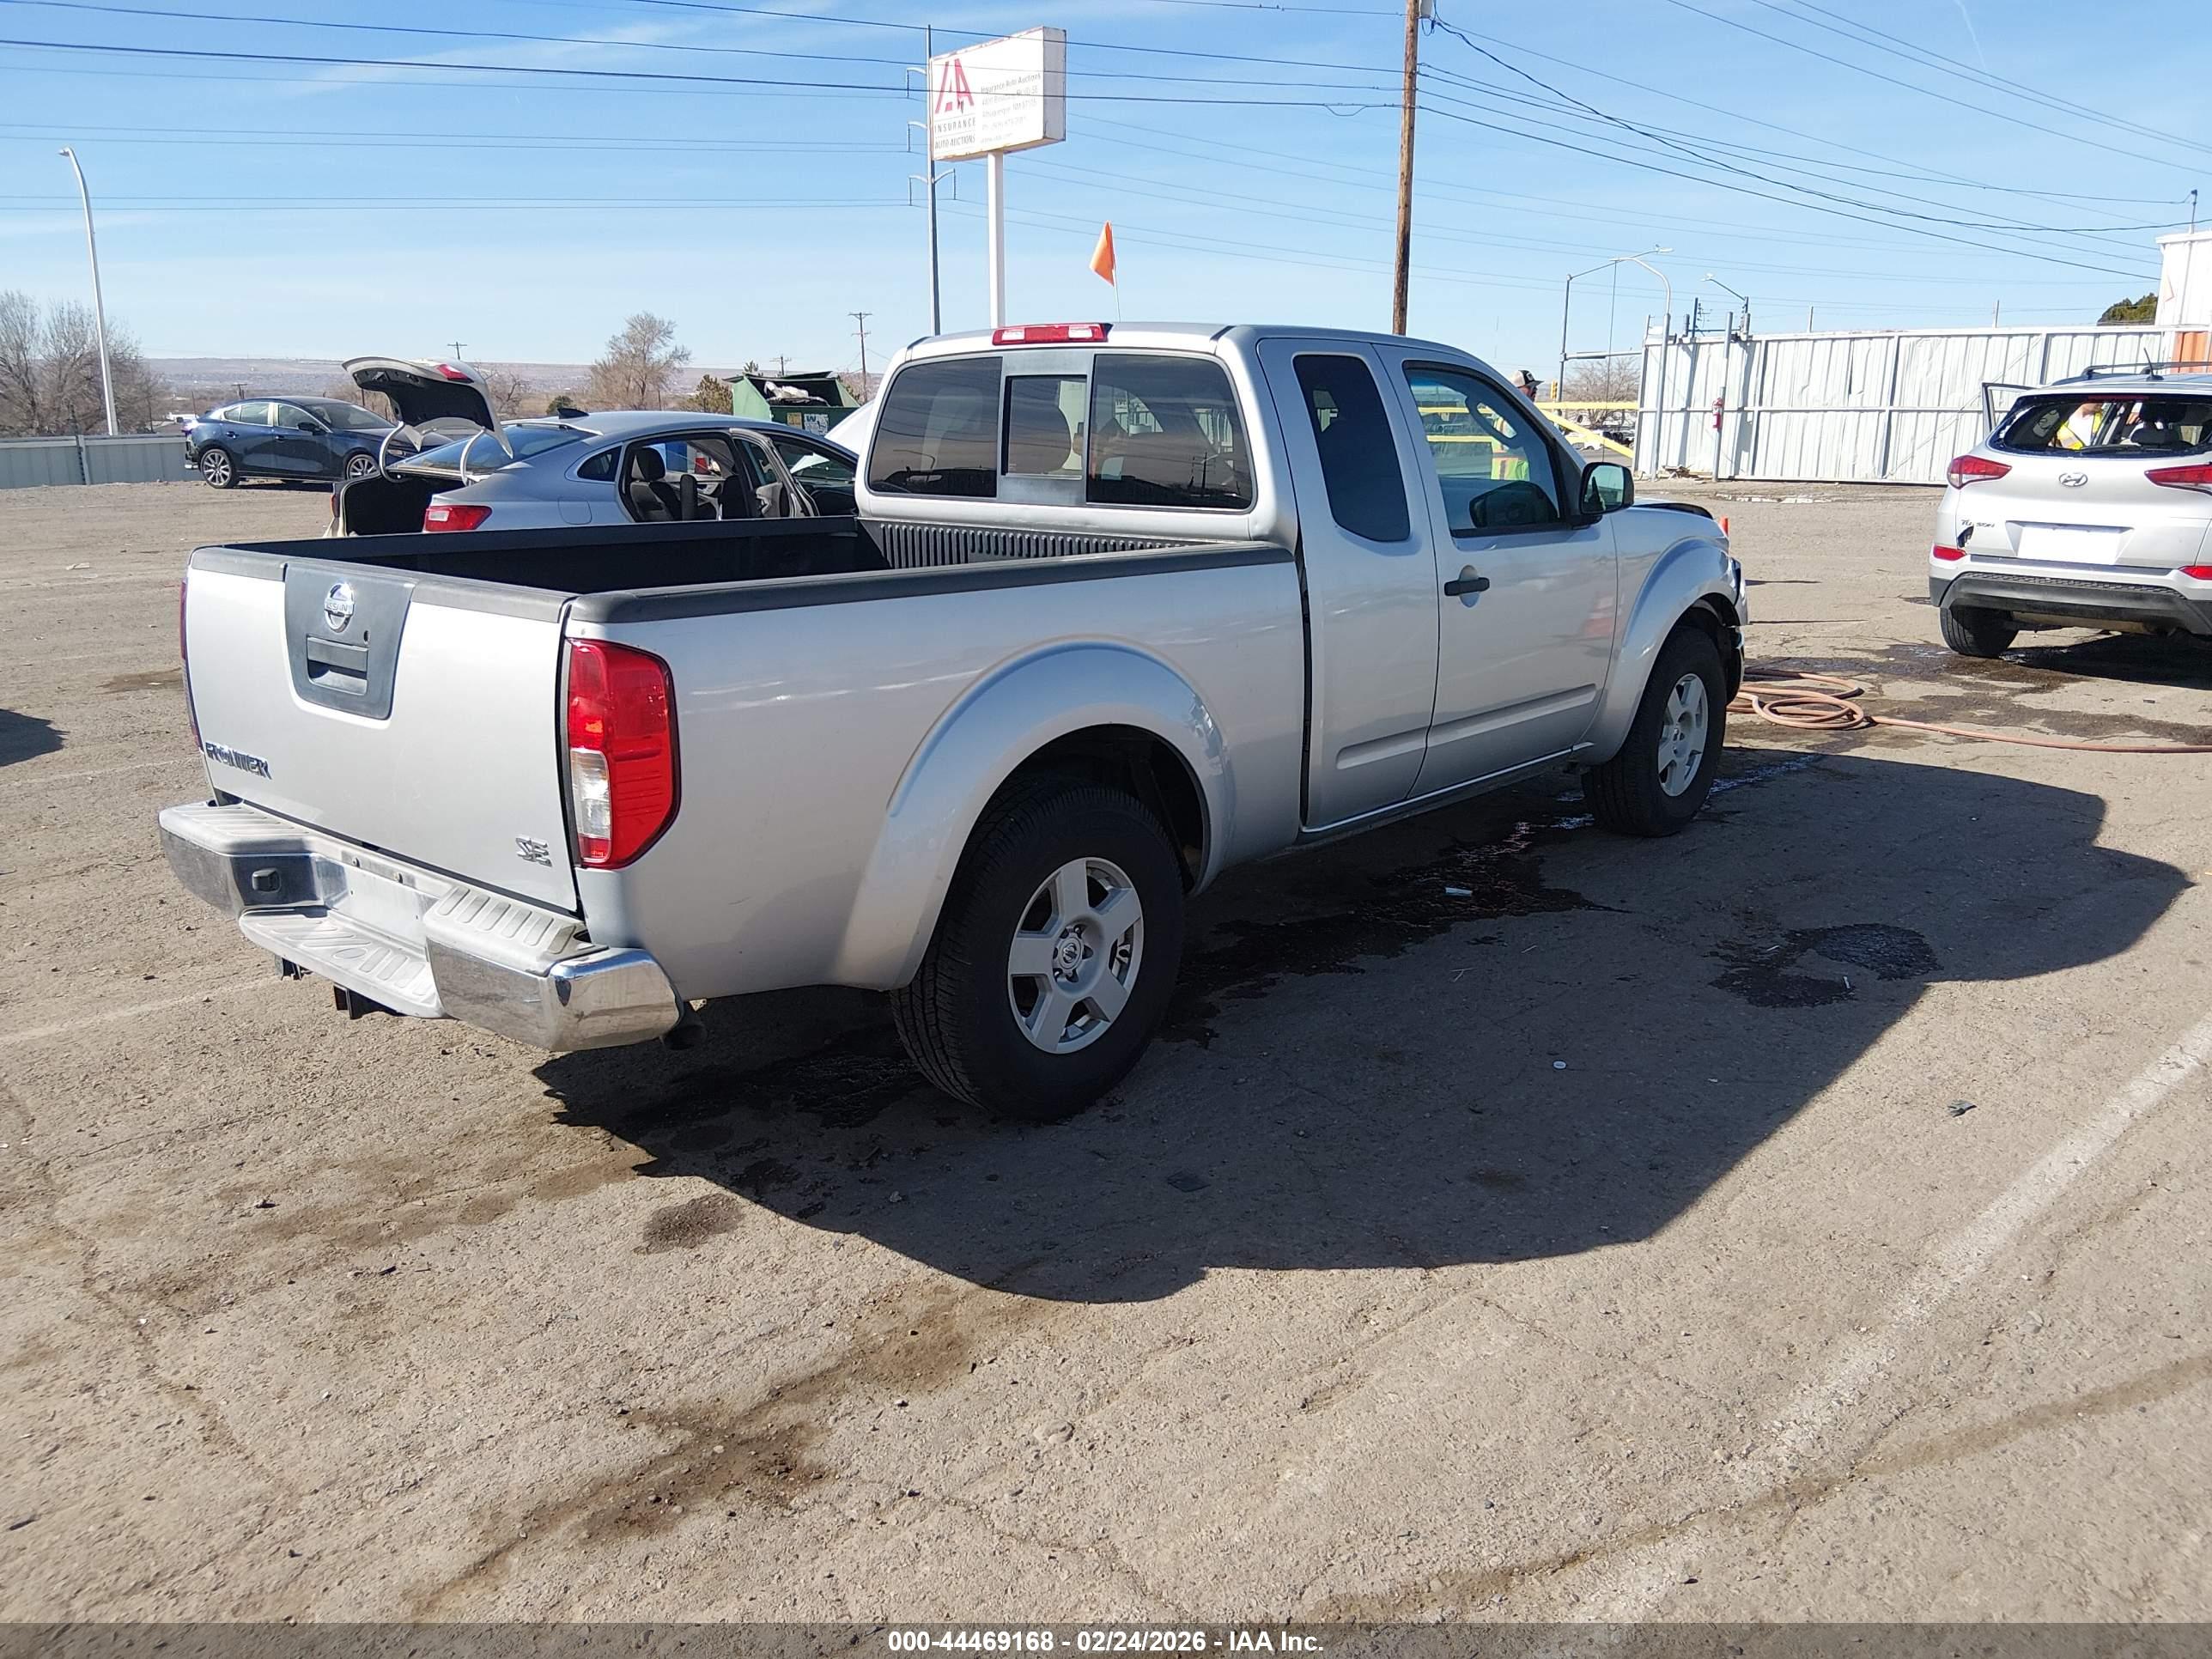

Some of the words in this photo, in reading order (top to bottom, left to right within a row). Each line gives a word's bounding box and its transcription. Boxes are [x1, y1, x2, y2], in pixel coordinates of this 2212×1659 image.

[934, 117, 976, 133] INSURANCE
[934, 137, 950, 150] AUTO
[950, 133, 975, 147] AUCTIONS
[1960, 519, 1996, 528] TUSON
[515, 836, 553, 868] SE
